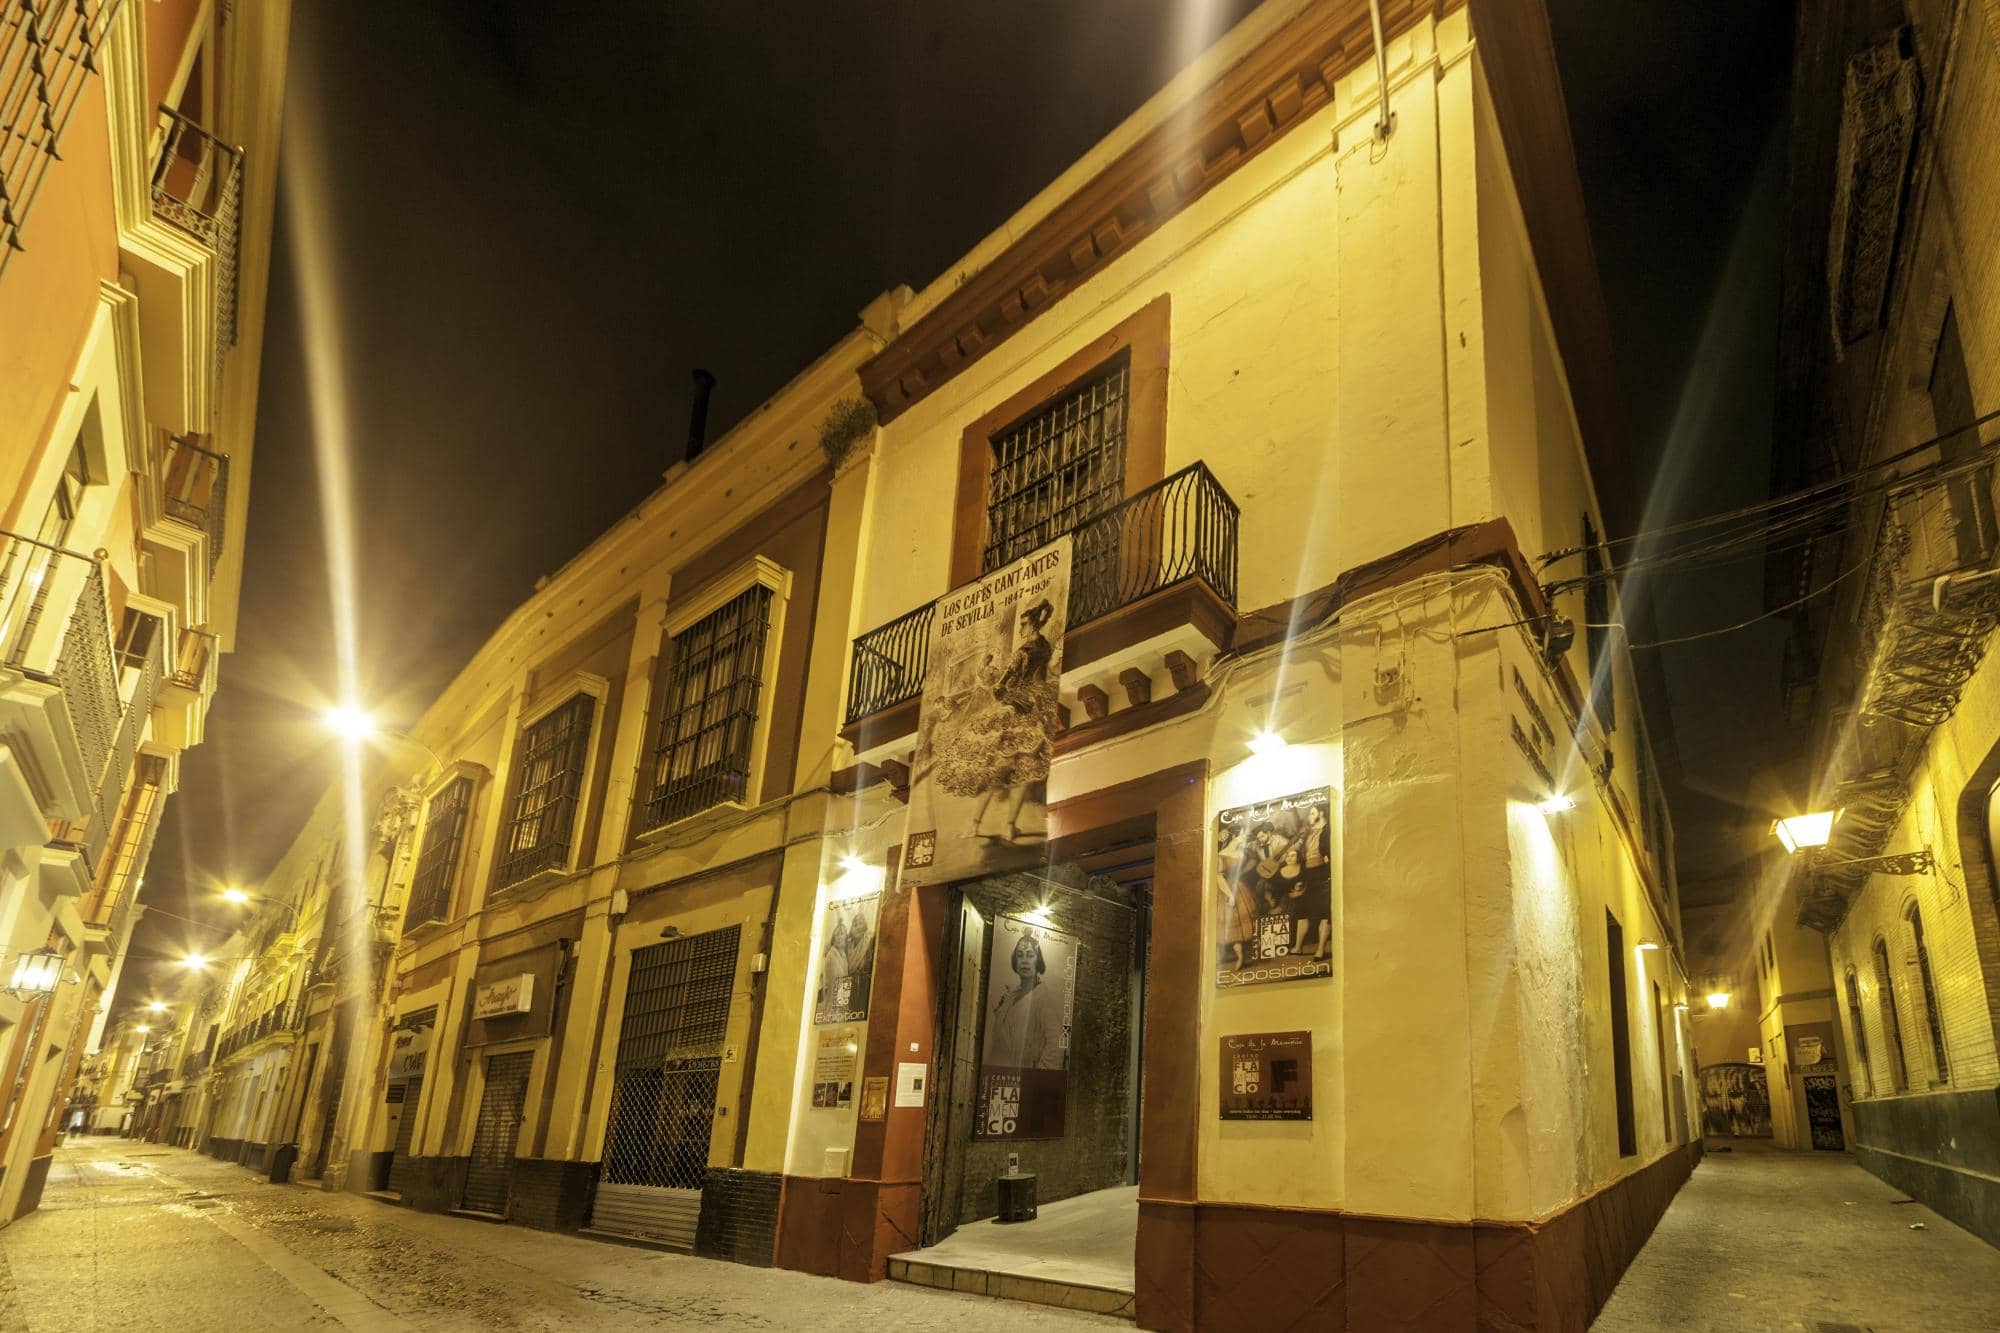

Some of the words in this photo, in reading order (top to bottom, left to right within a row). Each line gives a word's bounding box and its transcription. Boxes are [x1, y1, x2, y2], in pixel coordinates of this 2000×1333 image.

[943, 599, 961, 619] LOS
[994, 550, 1060, 594] CANTANTES
[941, 620, 954, 637] DE
[956, 601, 995, 631] SEVILLA
[1220, 811, 1244, 824] Casa
[1248, 805, 1260, 818] de
[1280, 792, 1327, 811] Memoria
[1261, 923, 1289, 935] FLA
[1262, 935, 1289, 946] MEN
[1262, 946, 1289, 958] CO
[1216, 961, 1330, 985] Exposición
[1234, 1062, 1259, 1071] FLA
[991, 1087, 1019, 1101] FLA
[1233, 1083, 1259, 1094] CO
[989, 1103, 1018, 1117] MEN
[988, 1120, 1017, 1134] CO
